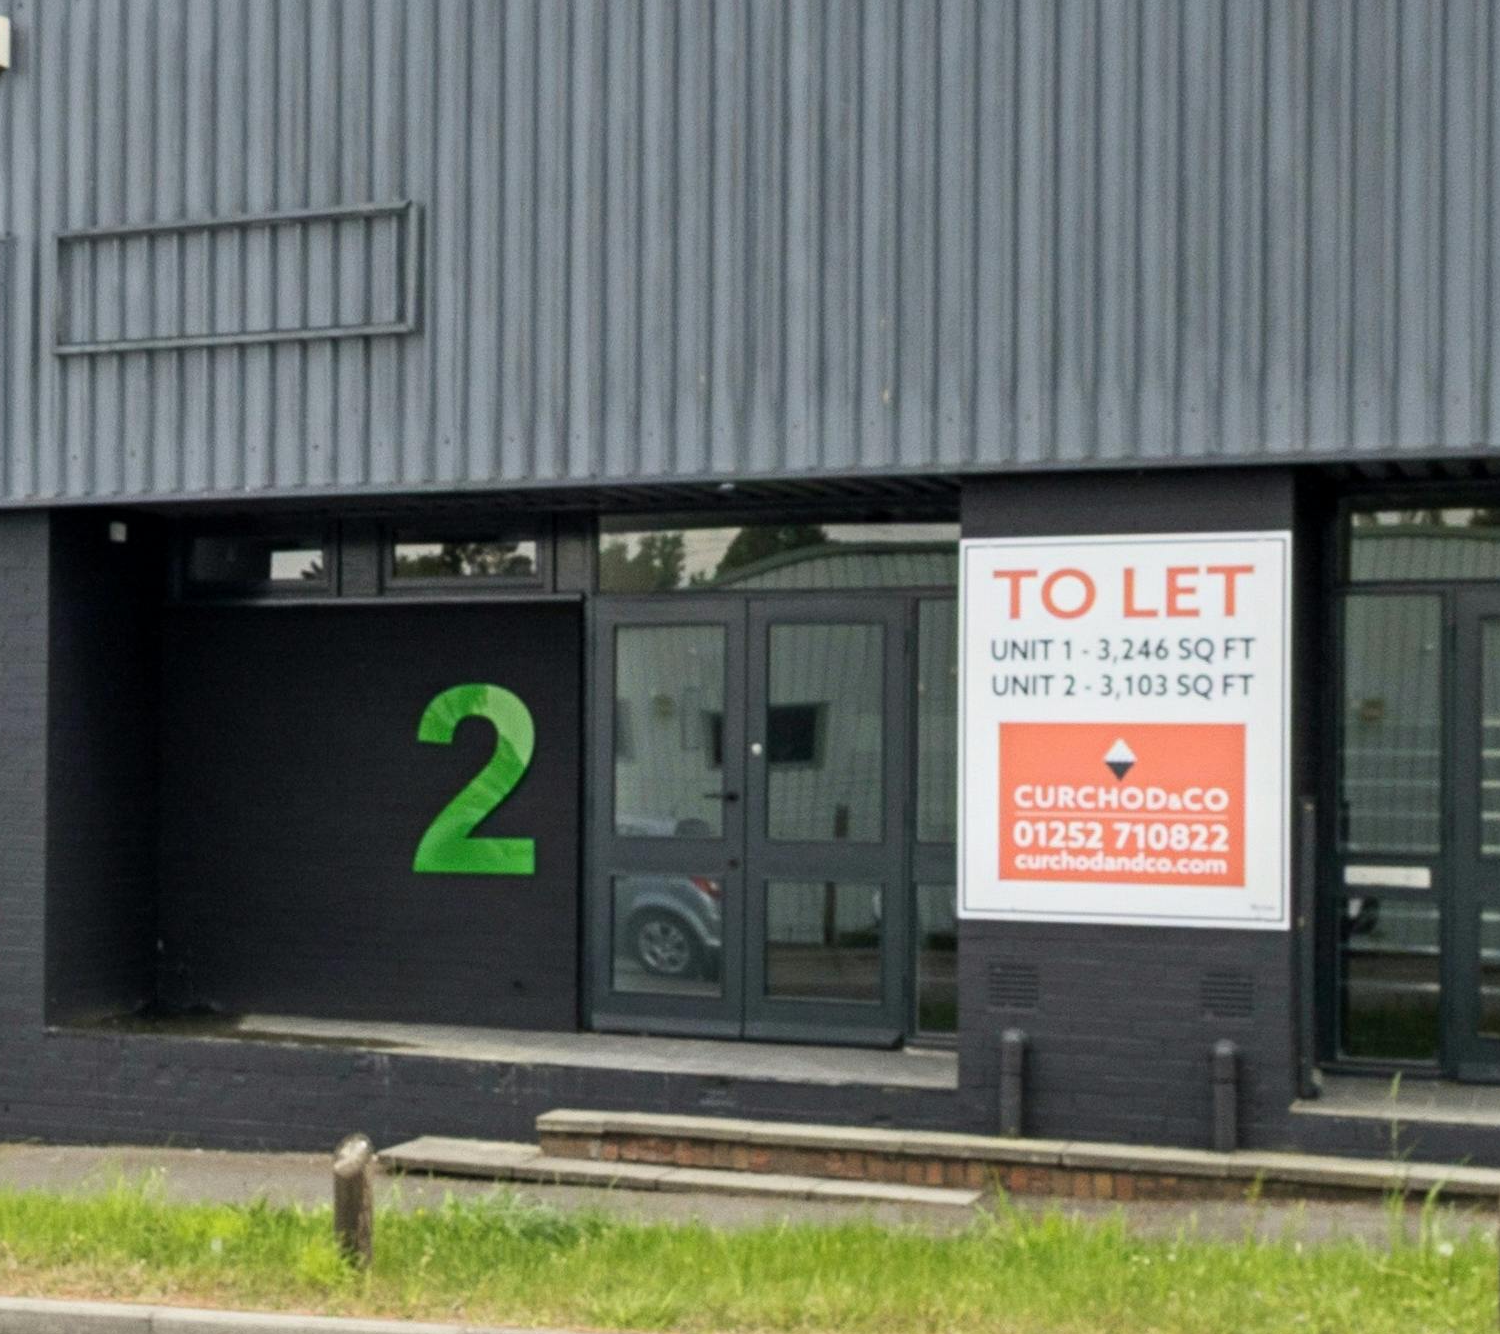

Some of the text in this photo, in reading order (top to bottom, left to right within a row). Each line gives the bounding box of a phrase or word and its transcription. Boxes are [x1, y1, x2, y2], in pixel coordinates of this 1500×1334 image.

[993, 565, 1256, 620] TO LET
[991, 638, 1054, 661] UNIT
[1063, 639, 1072, 661] 1
[1098, 638, 1169, 664] 3,246
[1178, 638, 1215, 665] SQ
[1224, 637, 1256, 660] FT
[991, 674, 1054, 697] UNIT
[1063, 674, 1076, 696] 2
[1100, 674, 1168, 699] 3,103
[1177, 674, 1214, 700] SQ
[1222, 673, 1255, 696] FT
[412, 682, 537, 875] 2
[1013, 784, 1230, 812] CURCHOD&CO
[1012, 820, 1230, 852] 01252 710822
[1014, 849, 1229, 875] curchodandco.com
